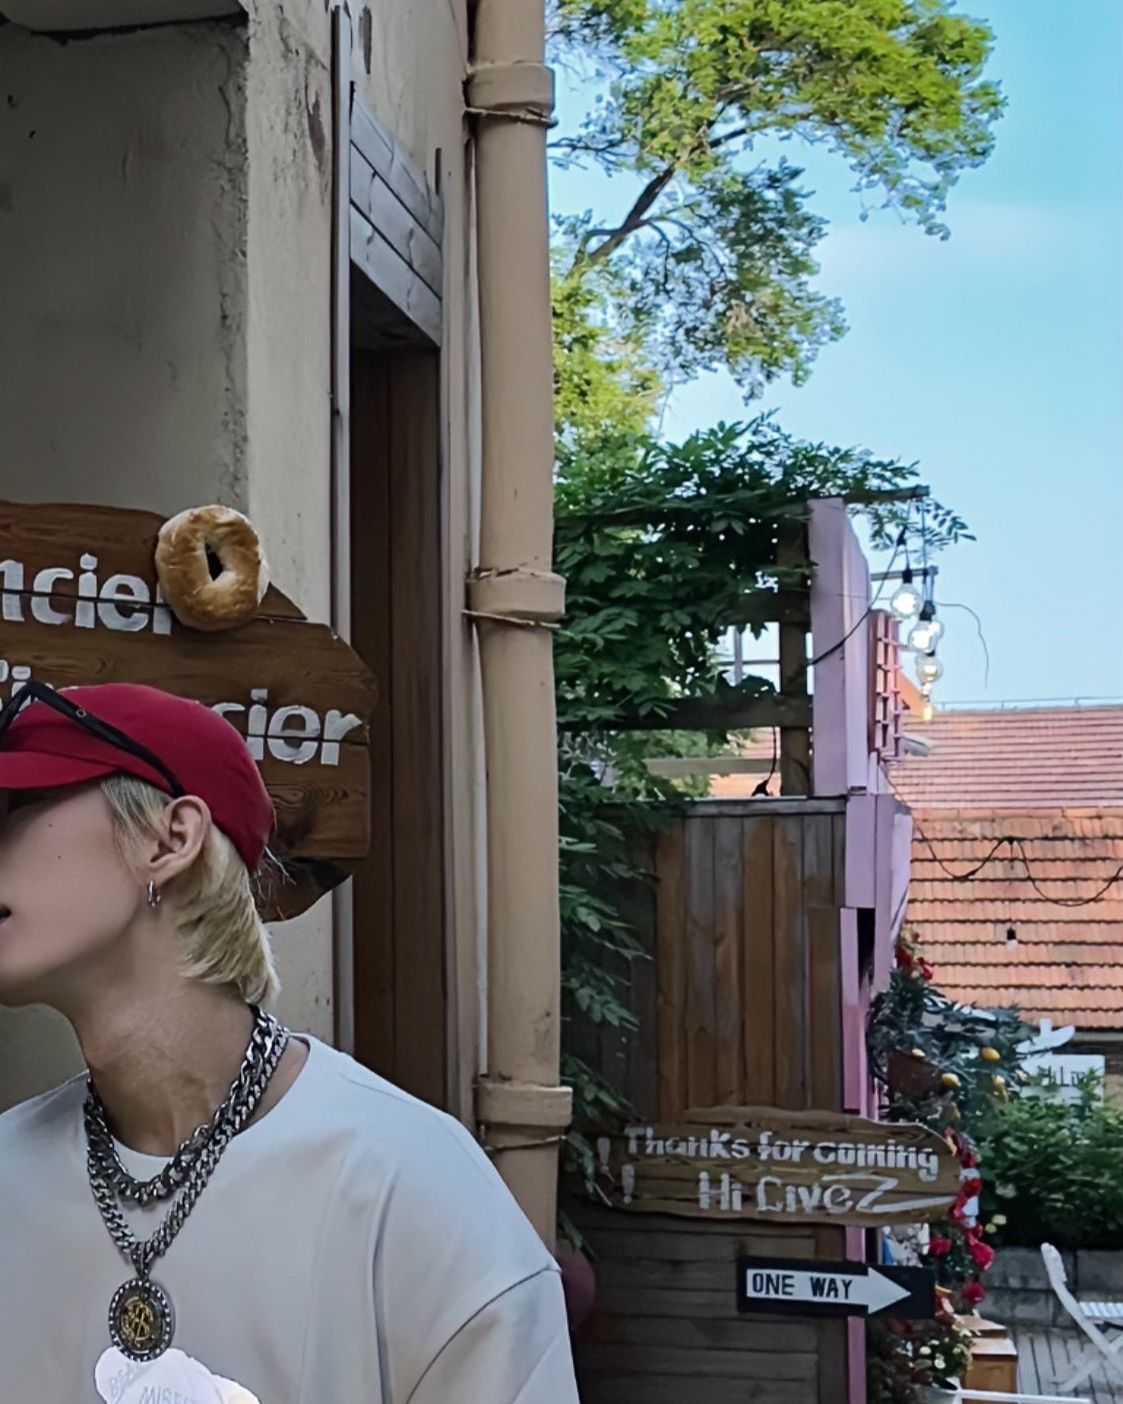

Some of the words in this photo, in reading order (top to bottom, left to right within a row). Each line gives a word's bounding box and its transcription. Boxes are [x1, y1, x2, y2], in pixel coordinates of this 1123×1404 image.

[757, 1131, 810, 1163] for
[699, 1171, 742, 1211] Hi
[752, 1272, 795, 1296] ONE
[810, 1276, 853, 1300] WAY
